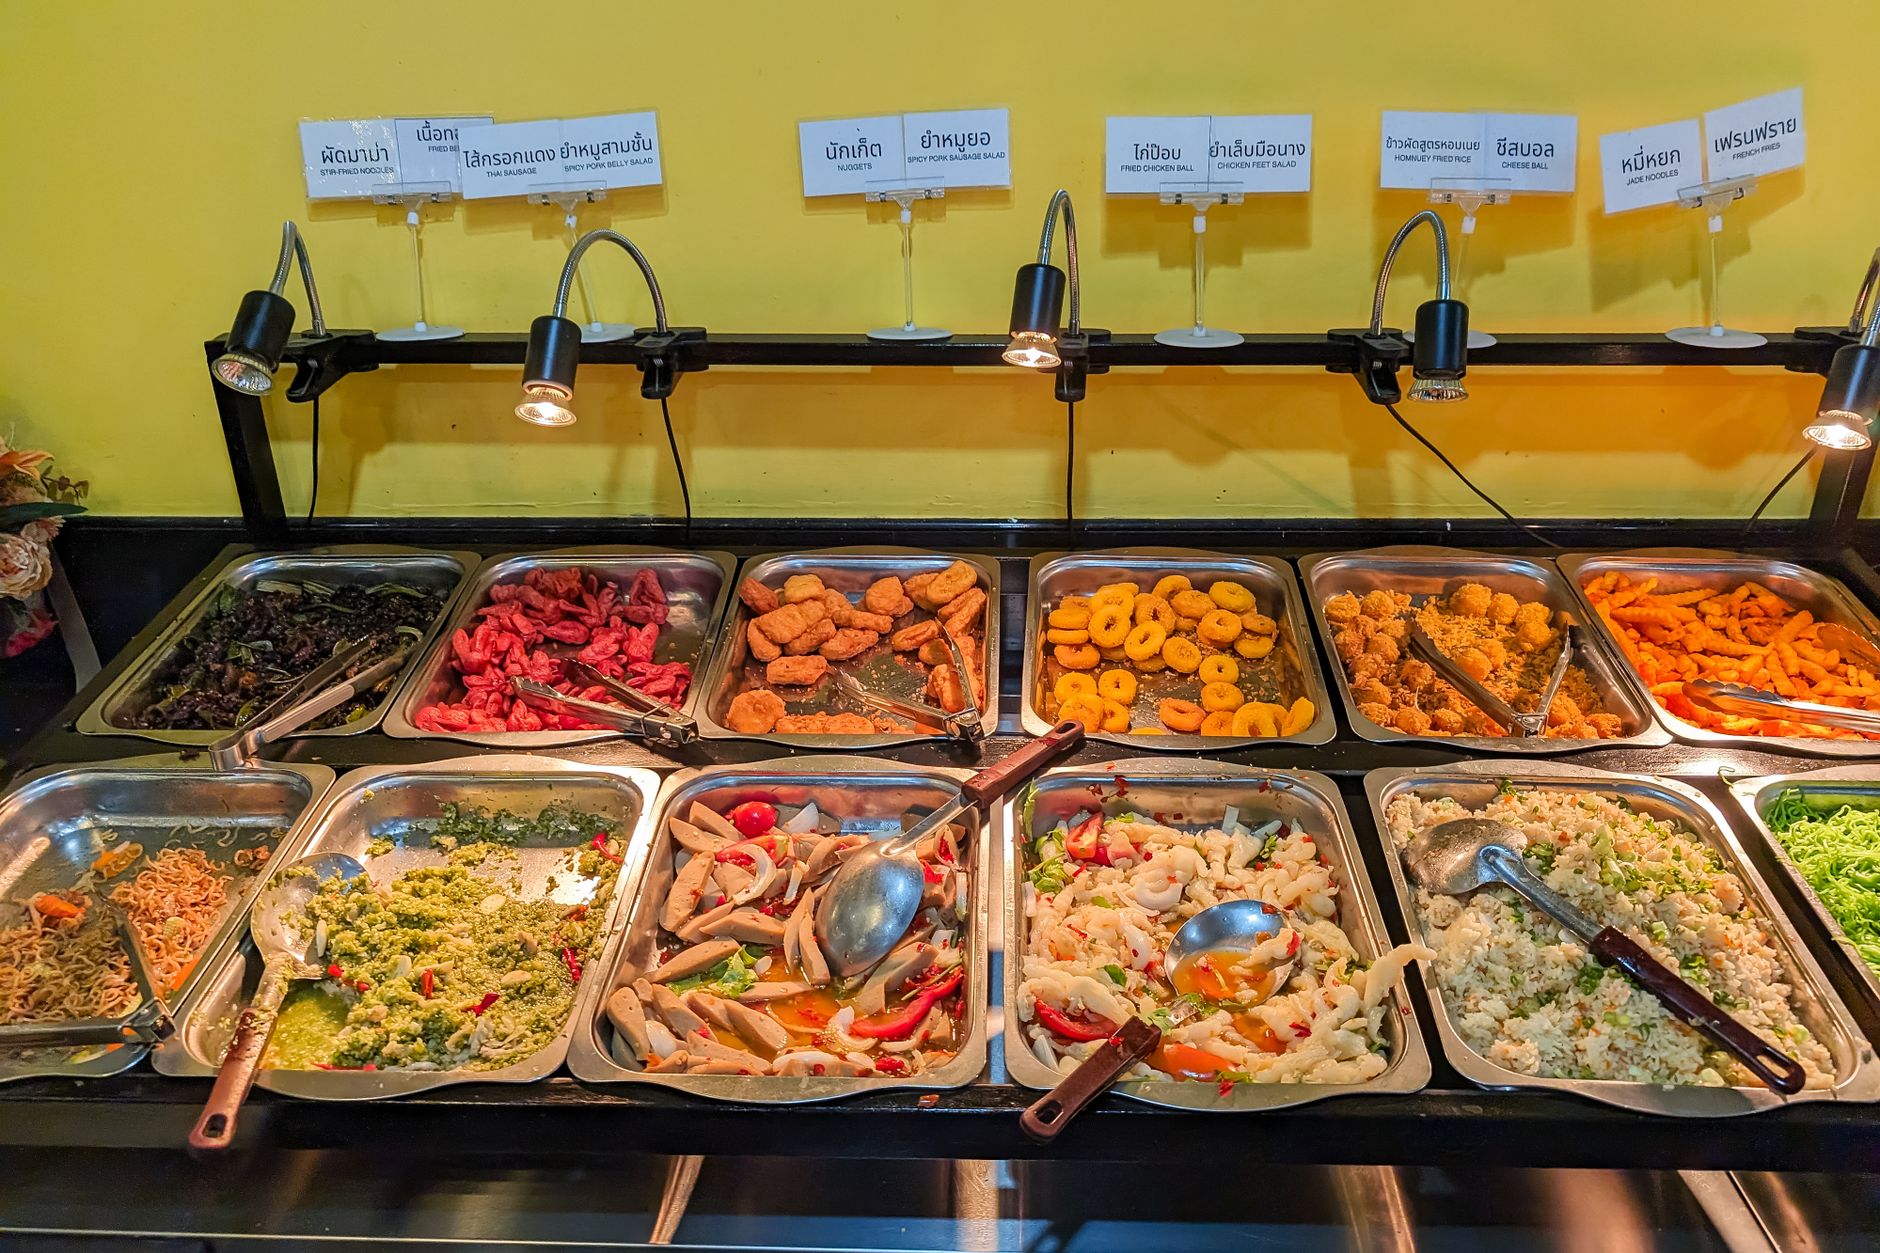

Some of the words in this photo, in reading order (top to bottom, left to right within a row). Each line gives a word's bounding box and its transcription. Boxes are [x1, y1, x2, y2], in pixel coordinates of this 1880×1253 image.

[921, 130, 991, 153] ยำหมูยอ
[1385, 135, 1481, 153] ข้าวผัดสูตรหอมเนย
[1714, 117, 1797, 153] เฟรนฟราย
[321, 141, 389, 164] ผัดมาม่า
[428, 145, 448, 153] FRIED
[560, 131, 653, 160] ยำหมูสามชั้น
[826, 137, 883, 160] นักเก็ต
[1208, 138, 1307, 159] ยำเล็บมือนาง
[1496, 136, 1554, 158] ชีสบอล
[1732, 147, 1761, 161] FRENCH
[1760, 141, 1781, 153] FRIES
[463, 147, 556, 169] ไส้กรอกแดง
[564, 164, 586, 173] SPICY
[586, 162, 607, 171] PORK
[607, 159, 629, 169] BELLY
[629, 156, 654, 166] SALAD
[907, 155, 929, 164] SPICY
[928, 155, 949, 163] PORK
[949, 152, 983, 162] SAUSAGE
[982, 151, 1006, 160] SALAD
[1217, 160, 1252, 170] CHICKEN
[1251, 160, 1272, 169] FEET
[1271, 159, 1297, 169] SALAD
[1394, 153, 1431, 163] HOMNUEY
[1431, 154, 1455, 163] FRIED
[1454, 154, 1472, 163] RICE
[1501, 160, 1531, 169] CHEESE
[1531, 161, 1549, 170] BALL
[1621, 145, 1681, 174] หมี่หยก
[320, 168, 359, 176] STIR-FRIED
[360, 166, 394, 175] NOODLES
[486, 170, 503, 178] THAI
[503, 166, 537, 177] SAUSAGE
[837, 162, 873, 172] NUGGETS
[1120, 164, 1142, 173] FRIED
[1142, 164, 1176, 173] CHICKEN
[1175, 164, 1195, 173] BALL
[1626, 175, 1645, 186] JADE
[1645, 168, 1679, 183] NOODLES
